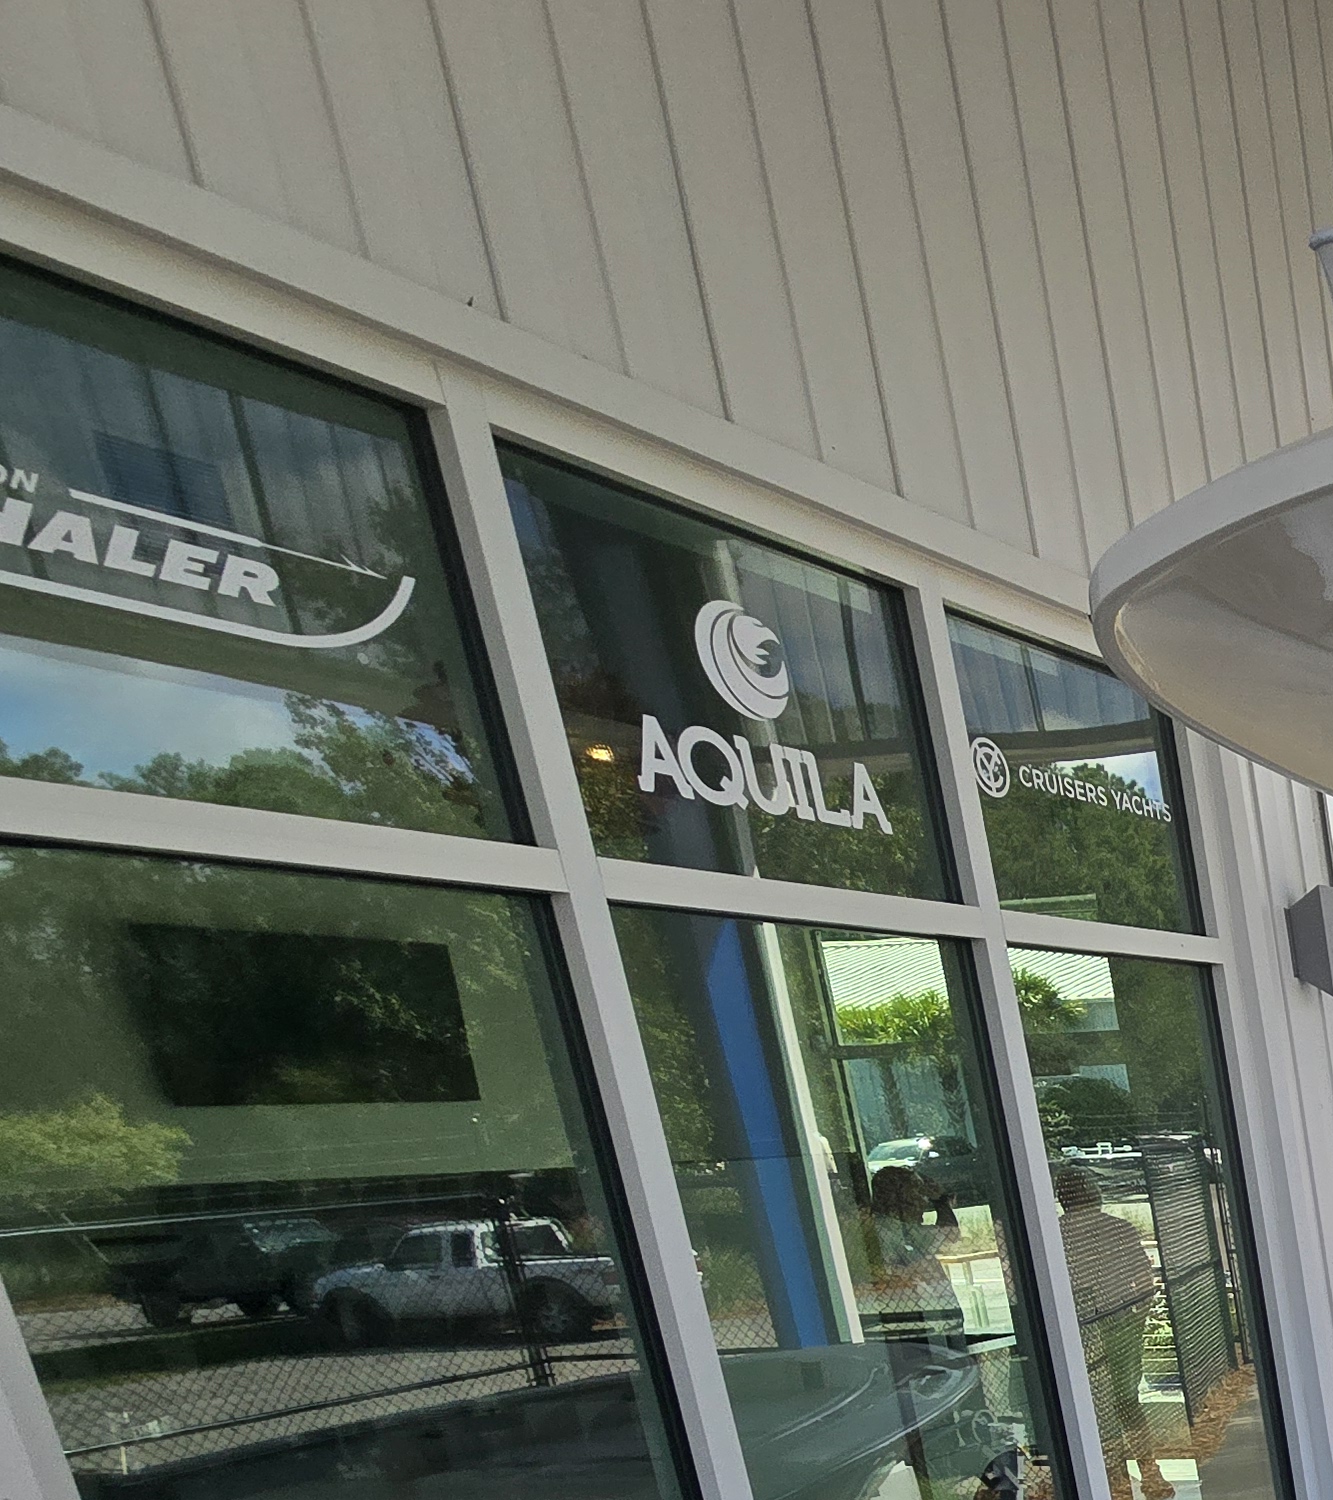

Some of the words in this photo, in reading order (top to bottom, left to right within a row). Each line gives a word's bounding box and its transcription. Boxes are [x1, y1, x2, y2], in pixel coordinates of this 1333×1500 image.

[638, 714, 893, 835] AQUILA
[1018, 765, 1108, 807] CRUISERS
[1111, 789, 1172, 823] YACHTS
